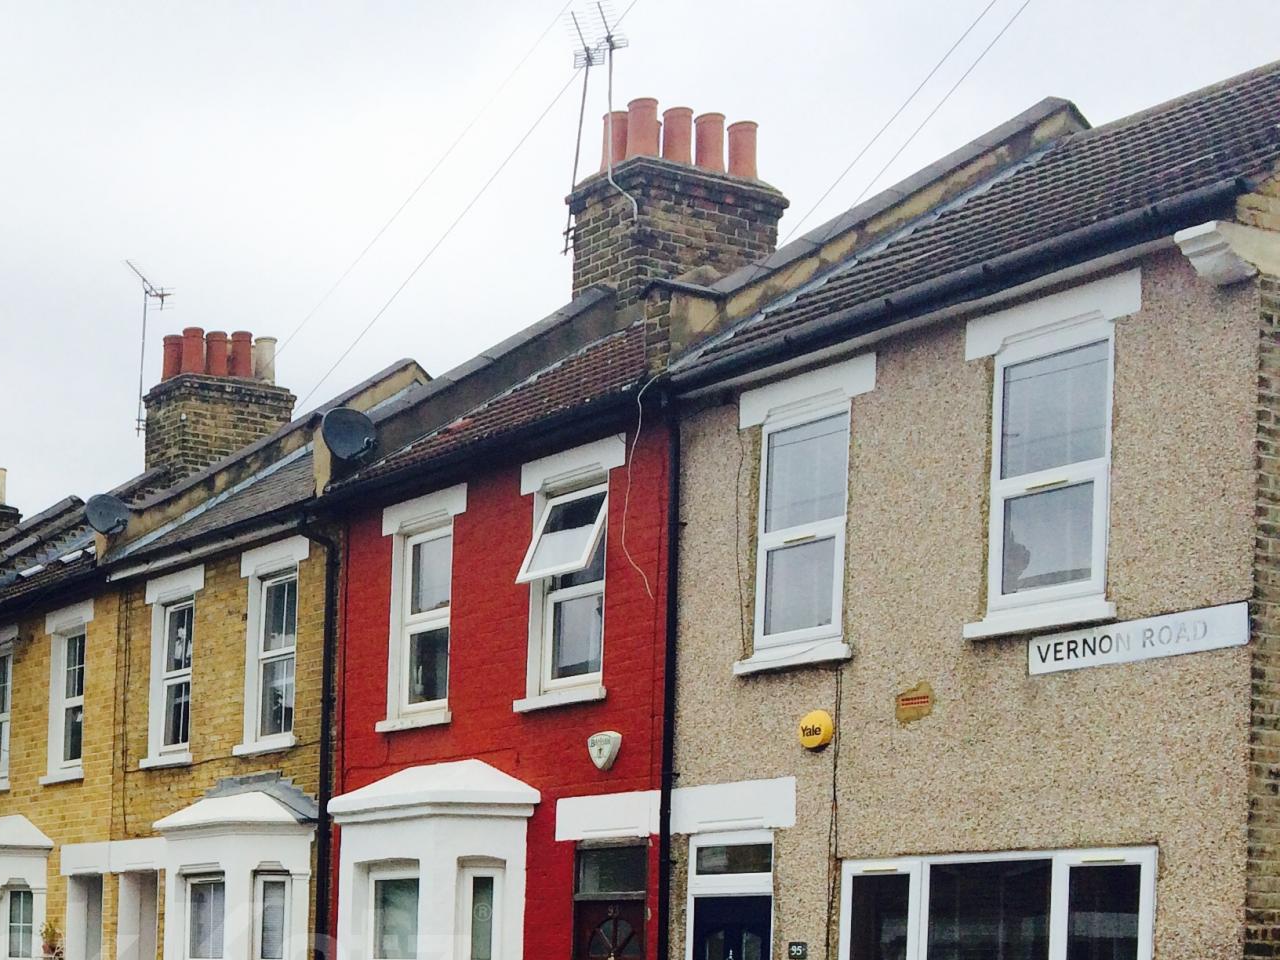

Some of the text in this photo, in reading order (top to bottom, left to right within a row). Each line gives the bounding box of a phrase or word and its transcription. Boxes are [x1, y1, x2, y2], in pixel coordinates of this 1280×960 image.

[1036, 620, 1209, 664] VERNON ROAD
[800, 725, 822, 737] Yale
[791, 945, 803, 956] 95
